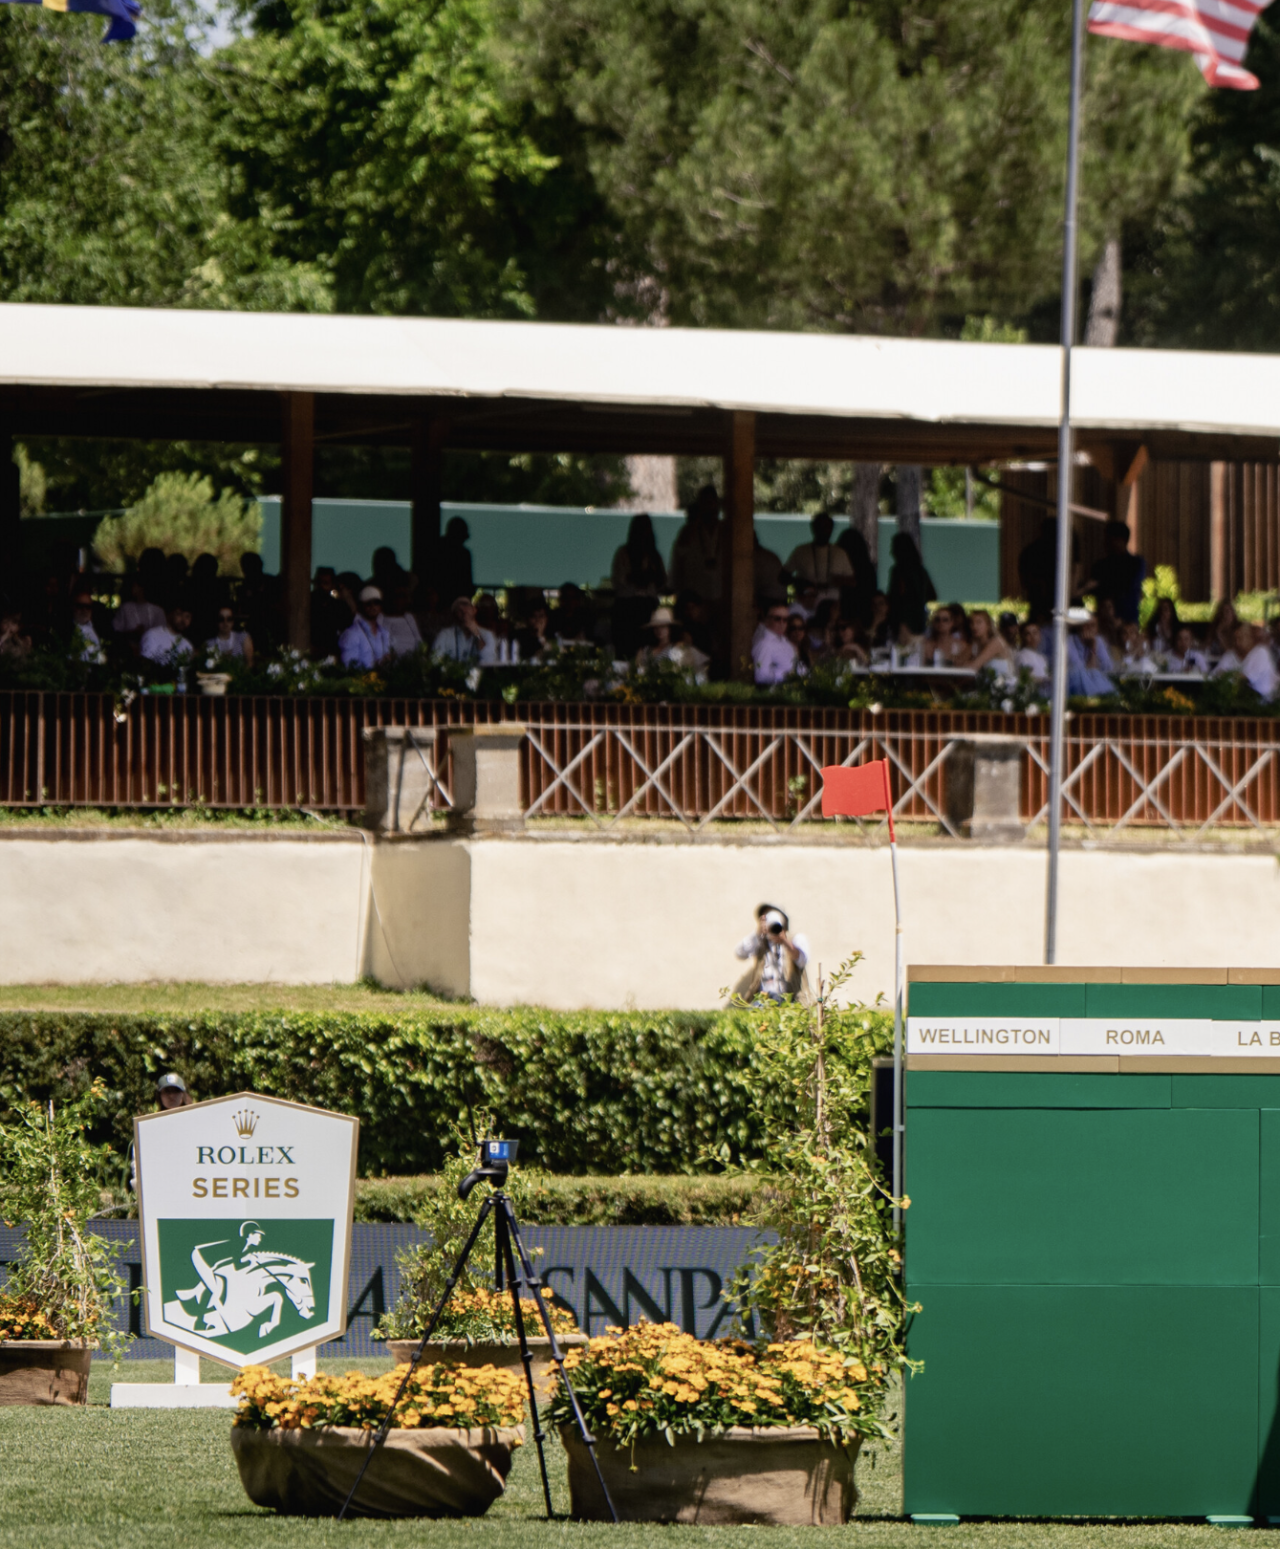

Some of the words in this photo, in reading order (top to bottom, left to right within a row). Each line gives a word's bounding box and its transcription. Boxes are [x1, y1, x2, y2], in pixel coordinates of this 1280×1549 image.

[919, 1028, 1051, 1046] WELLINGTON
[1105, 1029, 1166, 1046] ROMA
[1237, 1030, 1263, 1047] LA
[195, 1145, 296, 1165] ROLEX
[191, 1177, 301, 1199] SERIES
[538, 1265, 758, 1342] SANPA
